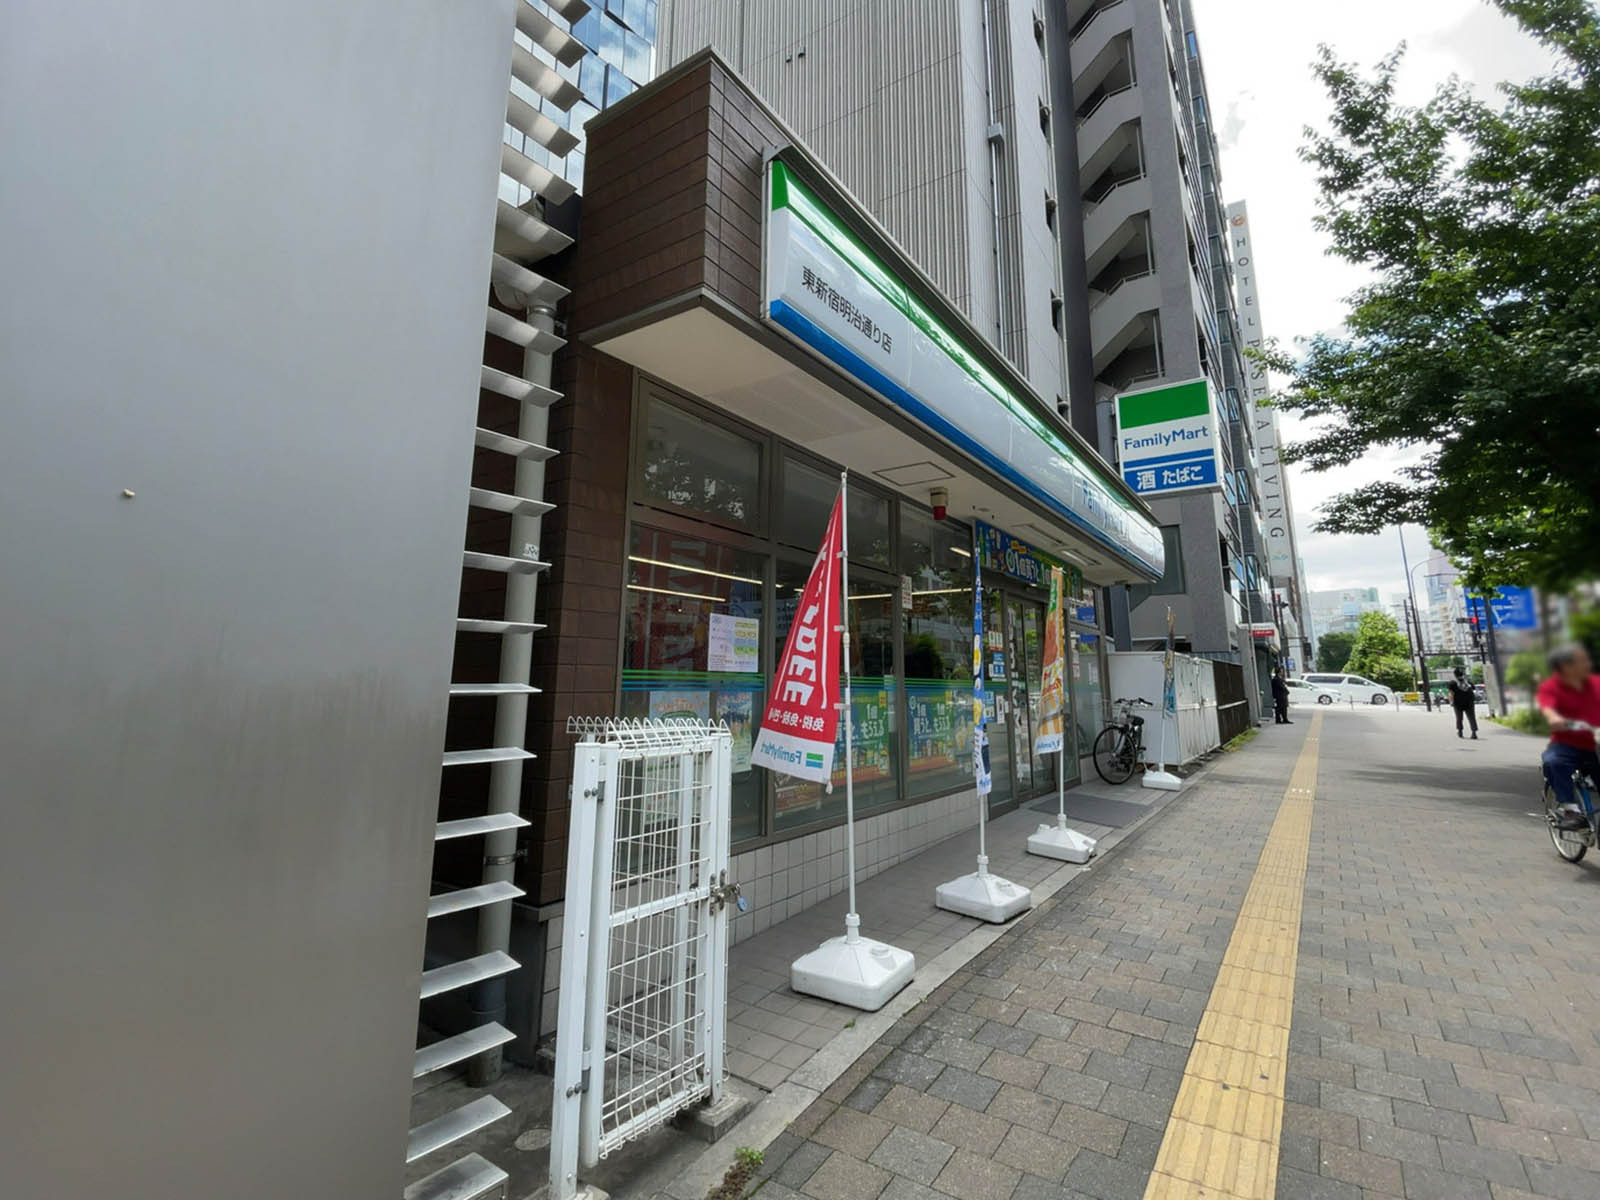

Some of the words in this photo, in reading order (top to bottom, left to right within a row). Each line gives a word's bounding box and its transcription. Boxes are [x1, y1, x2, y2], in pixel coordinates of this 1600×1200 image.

[802, 266, 893, 354] 東新宿明治通り店
[1236, 238, 1256, 327] HOTEL
[1247, 339, 1271, 431] PSEA
[1260, 446, 1285, 538] LIVING
[1124, 426, 1209, 450] FamilyMart
[1137, 470, 1157, 490] 酒
[1162, 465, 1204, 486] たばこ
